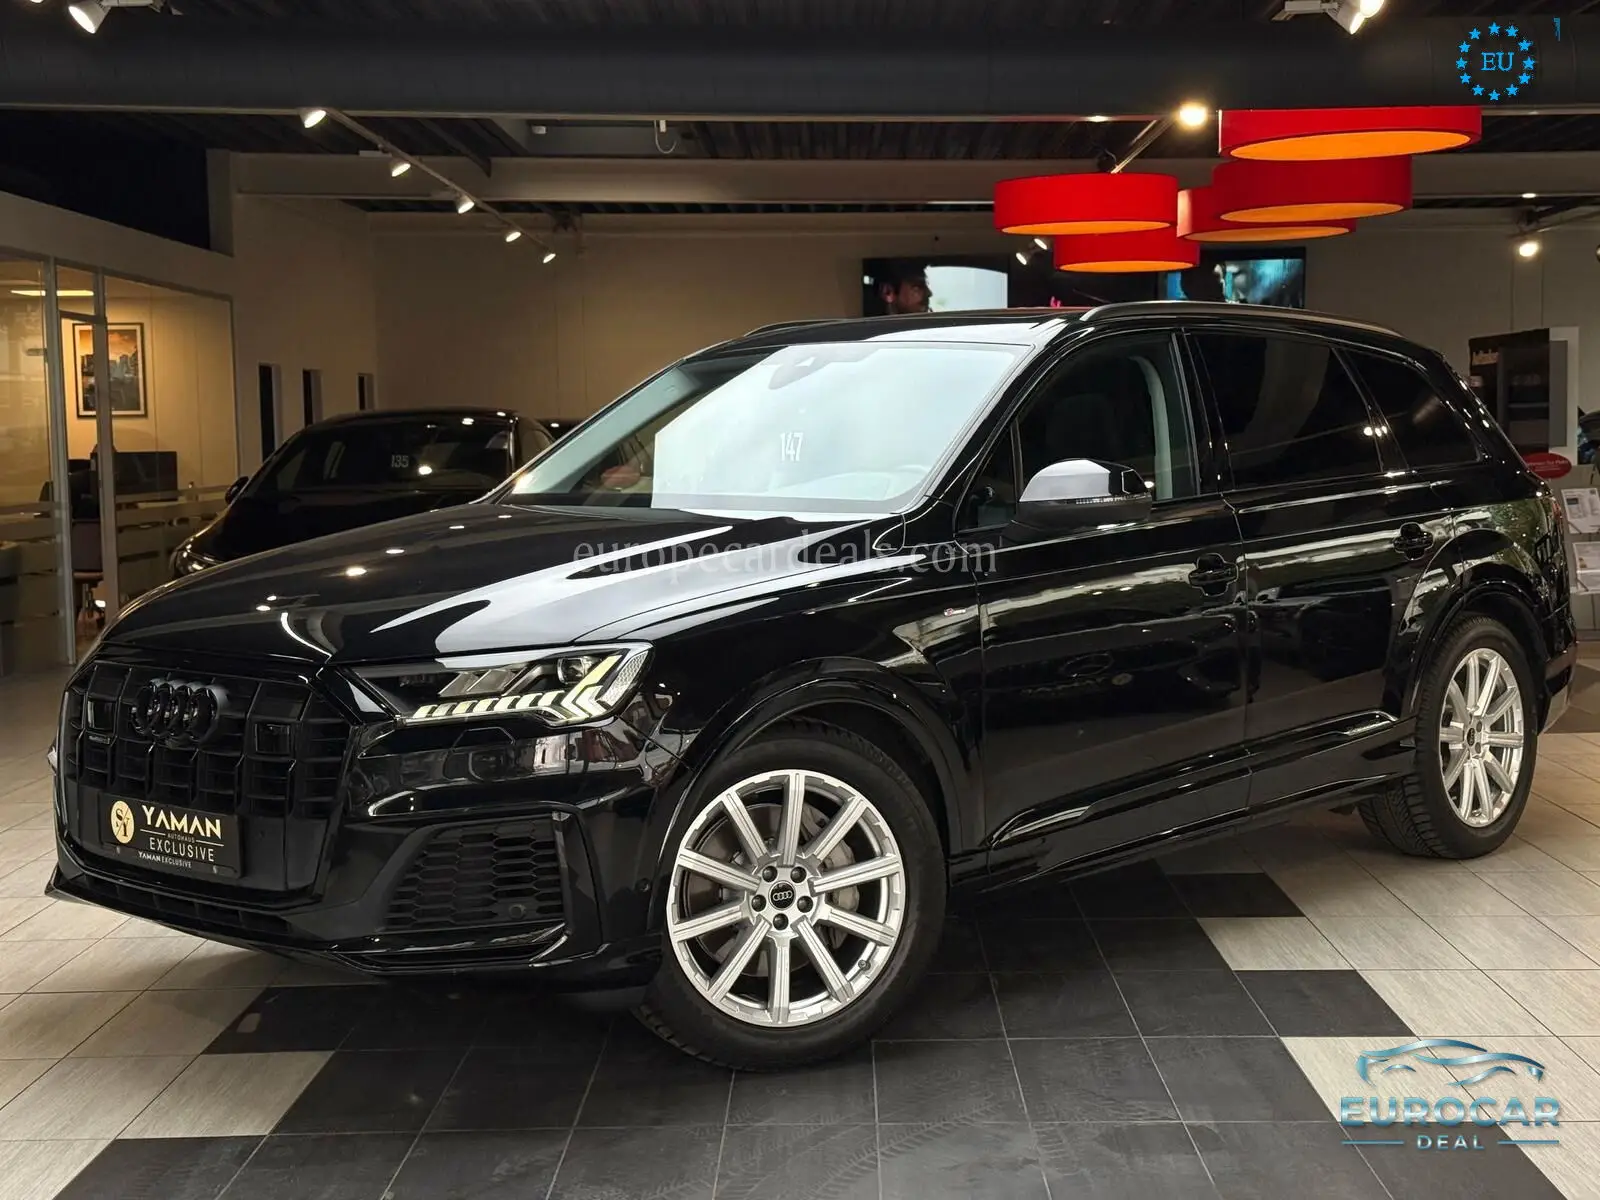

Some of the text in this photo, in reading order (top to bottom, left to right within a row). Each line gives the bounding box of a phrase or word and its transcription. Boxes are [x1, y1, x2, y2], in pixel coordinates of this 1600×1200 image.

[780, 432, 804, 462] 147
[391, 454, 409, 468] 135
[142, 805, 221, 840] YAMAN
[167, 832, 196, 843] AUTOHAUS
[138, 851, 192, 868] YAMAN EXCLUSIVE
[149, 837, 215, 862] EXCLUSIVE
